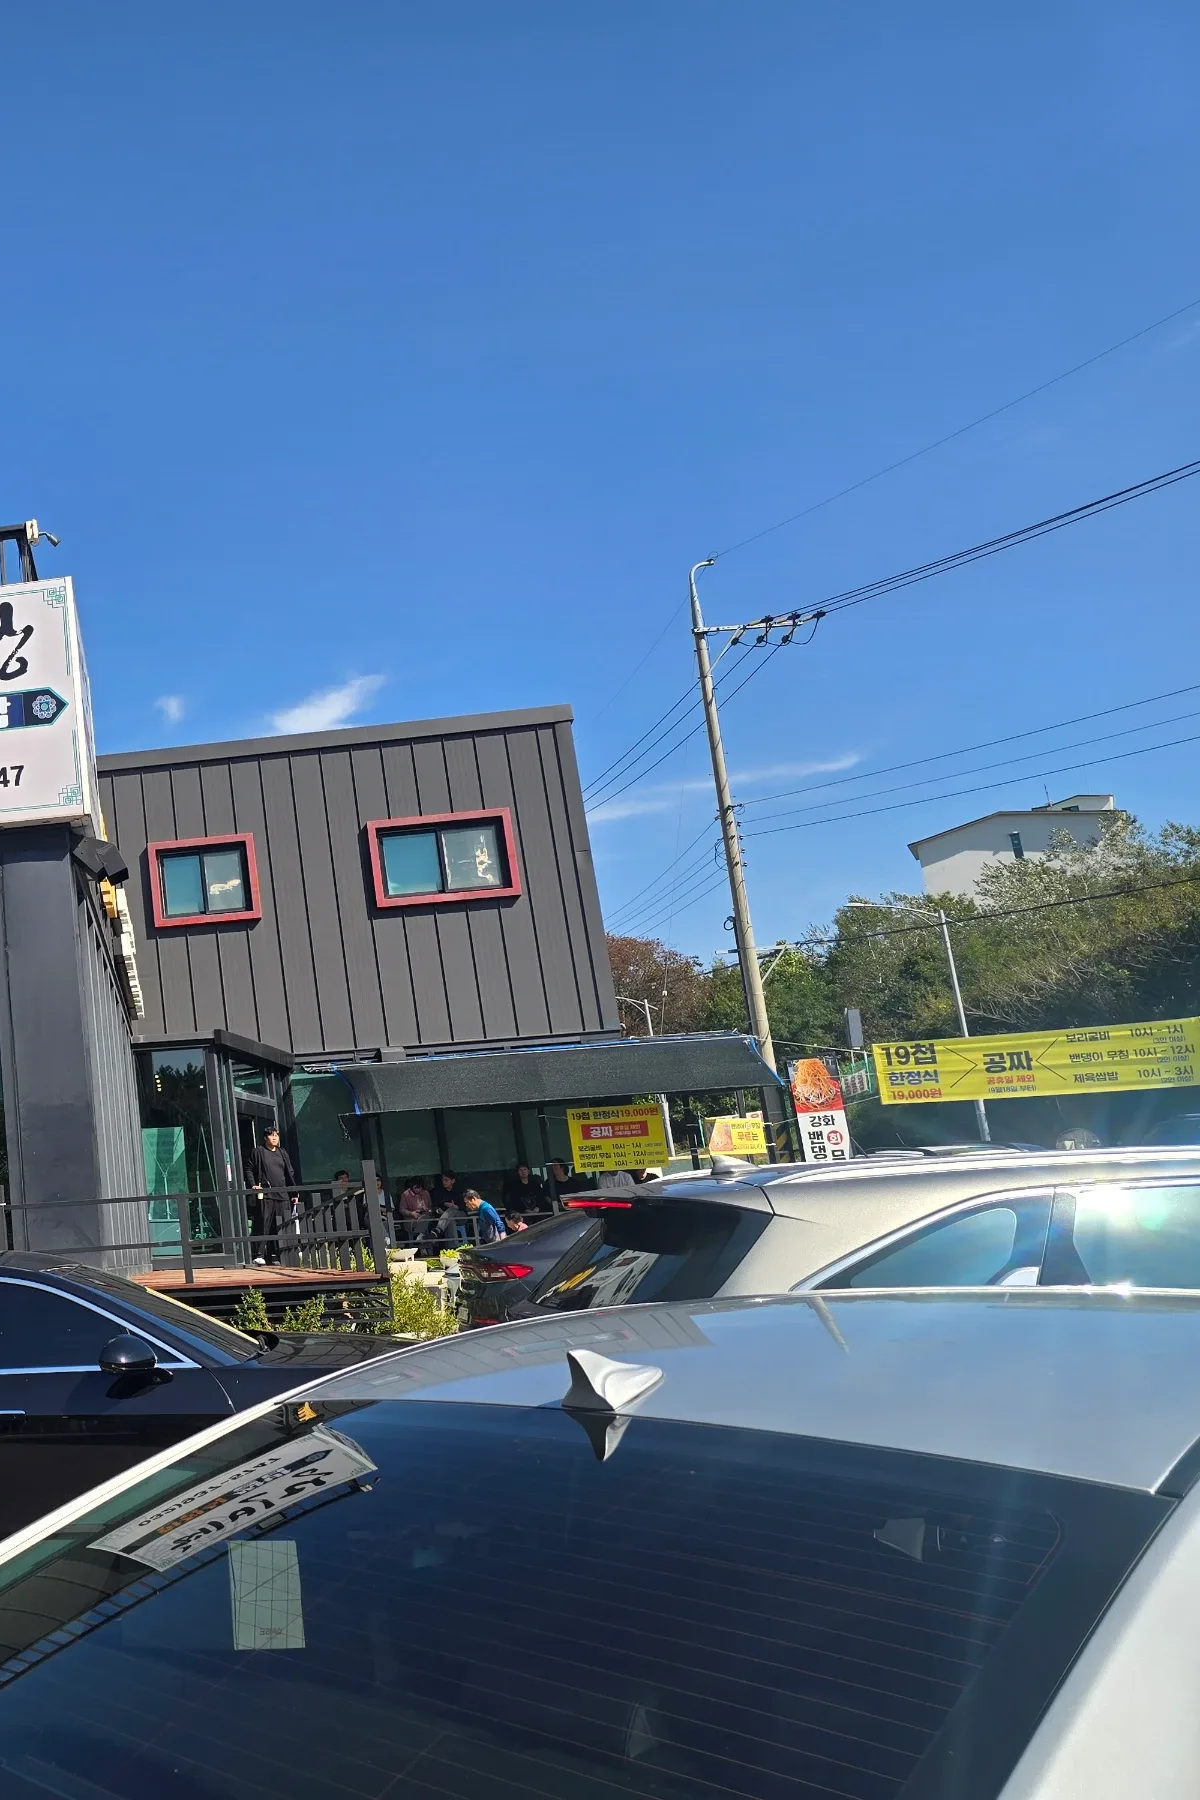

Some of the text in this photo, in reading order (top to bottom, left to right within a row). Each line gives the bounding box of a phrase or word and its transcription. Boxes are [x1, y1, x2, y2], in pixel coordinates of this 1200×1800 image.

[1066, 1031, 1110, 1043] 보리굴비
[1129, 1027, 1153, 1038] 10시
[1166, 1024, 1183, 1034] 1시
[881, 1043, 937, 1066] 19첩
[1069, 1052, 1103, 1063] 밴댕이
[1107, 1050, 1129, 1061] 무침
[1133, 1047, 1158, 1058] 10시
[1171, 1044, 1195, 1054] 12시
[983, 1051, 1033, 1073] 공짜
[888, 1069, 940, 1086] 한정식
[987, 1074, 1035, 1085] 공휴일 제외
[1137, 1068, 1161, 1079] 10시
[1175, 1065, 1193, 1076] 3시
[891, 1088, 942, 1101] 19,000원
[592, 1110, 619, 1119] 한정식
[809, 1115, 835, 1127] 강화
[590, 1125, 613, 1137] 공짜
[808, 1131, 828, 1161] 밴댕
